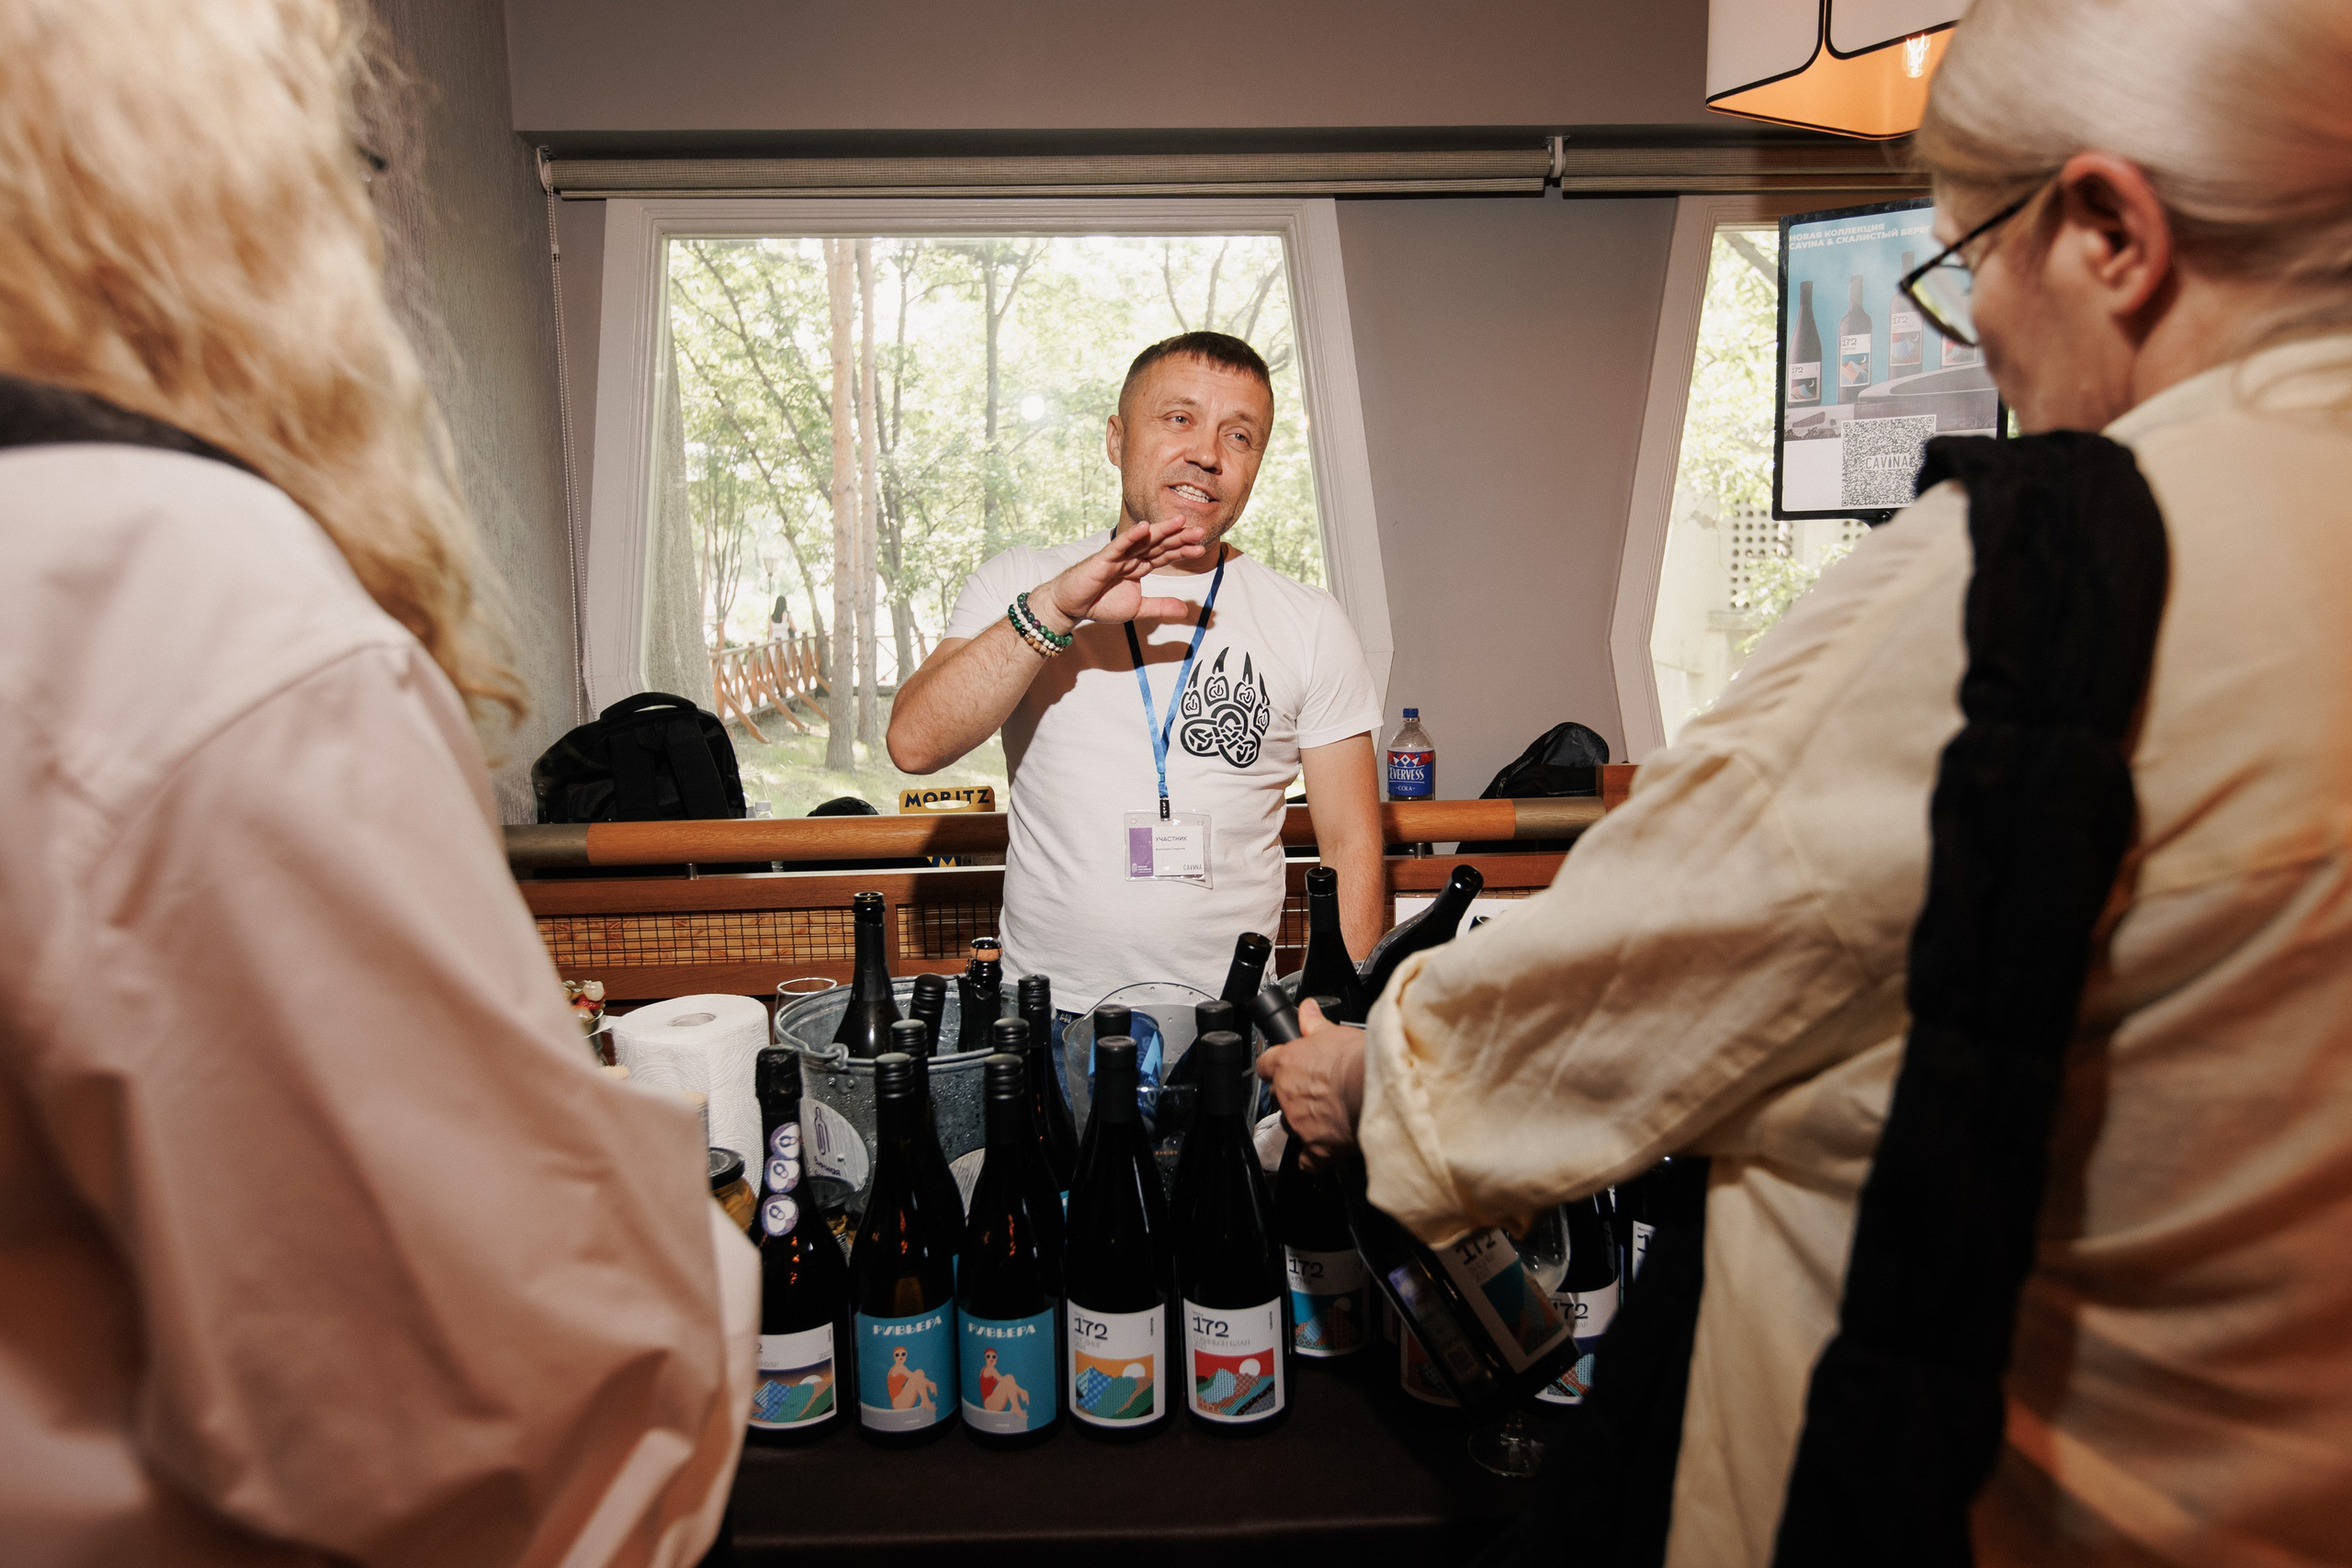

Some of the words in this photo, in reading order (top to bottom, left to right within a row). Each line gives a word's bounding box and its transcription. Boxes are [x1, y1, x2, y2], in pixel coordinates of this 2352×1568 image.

[1790, 231, 1823, 242] НОВАЯ
[1825, 223, 1885, 238] КОЛЛЕКЦИЯ
[1790, 240, 1825, 250] CAVINA
[1836, 228, 1898, 244] СКАЛИСТЫЙ
[1841, 337, 1857, 346] 172
[1865, 456, 1908, 469] CAVINA
[1389, 768, 1424, 780] EVERVESS
[905, 789, 990, 807] MORITZ
[1182, 863, 1203, 872] CAVINA
[1289, 1258, 1324, 1278] 172
[1553, 1302, 1589, 1320] 72
[873, 1314, 943, 1336] РИВЬЕРА
[967, 1322, 1036, 1338] РИВЬЕРА
[1074, 1316, 1108, 1340] 172
[1193, 1315, 1229, 1337] 172
